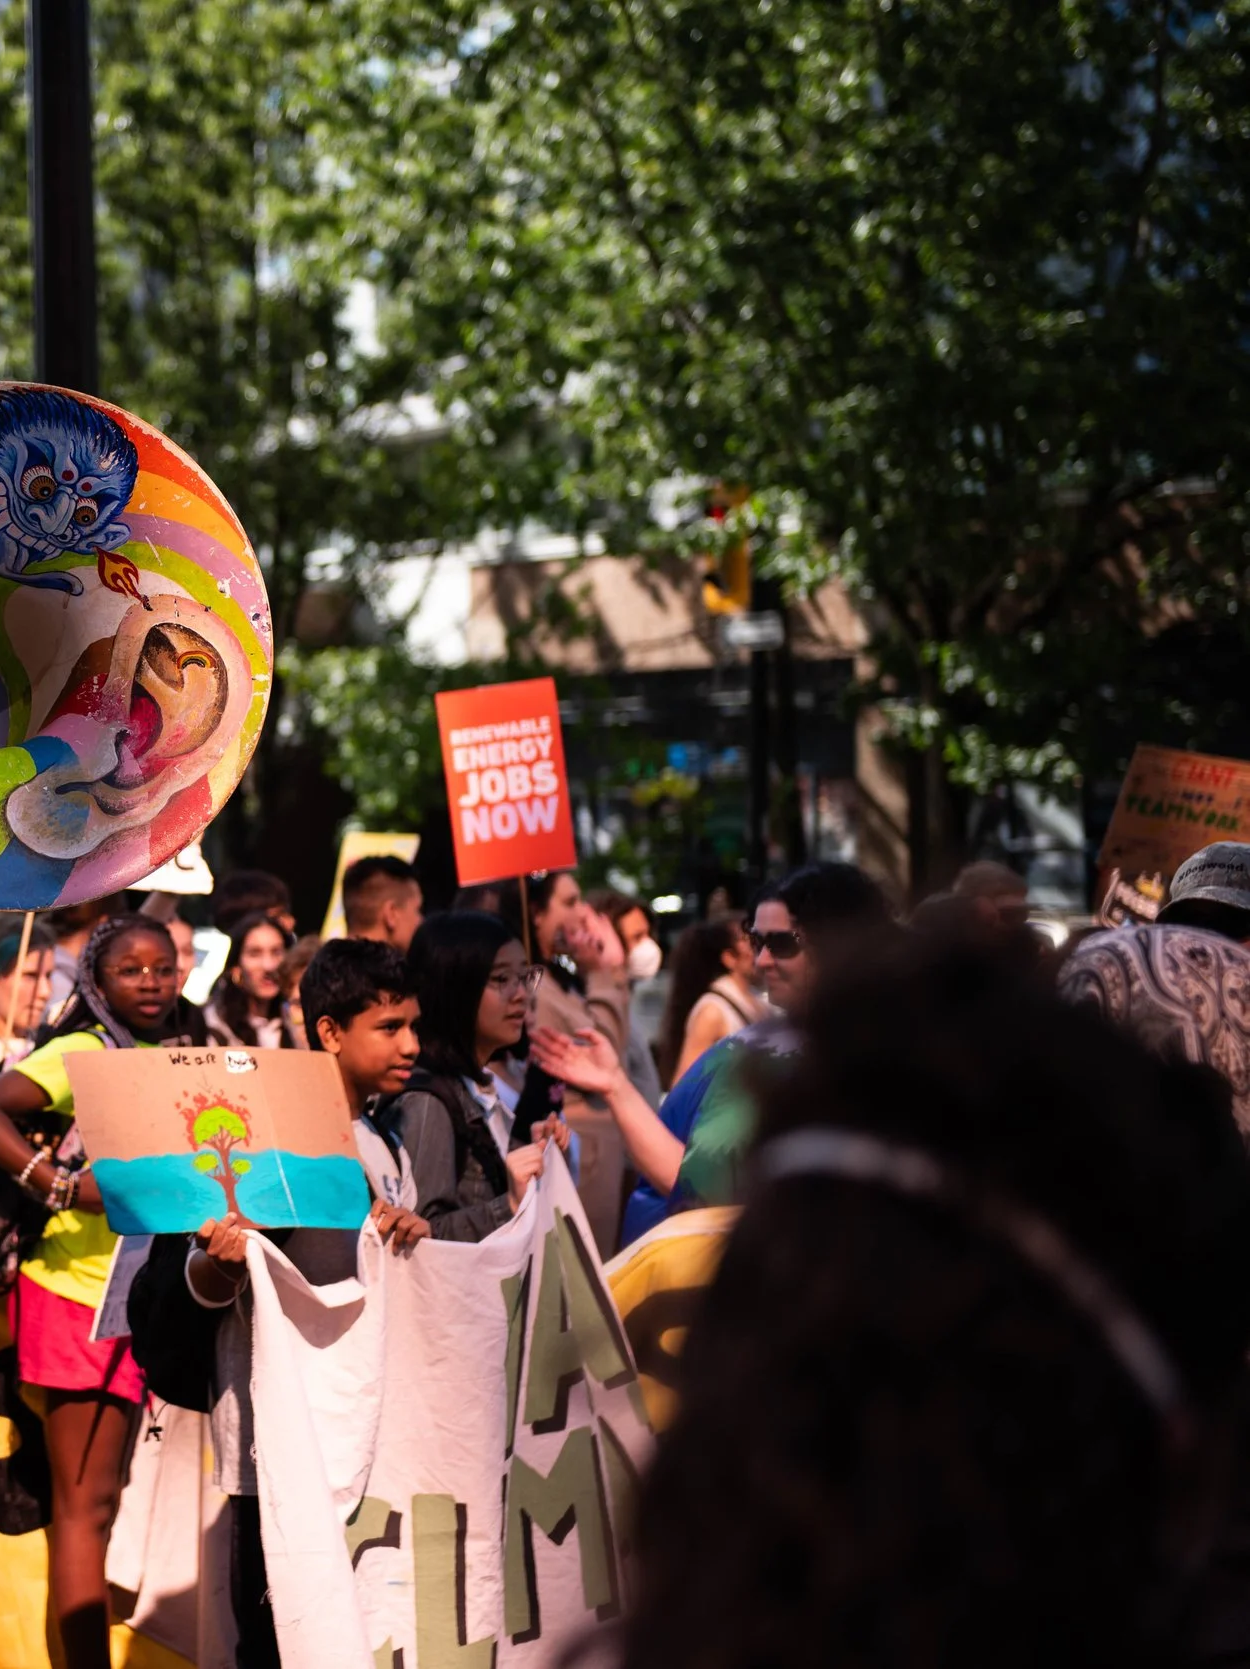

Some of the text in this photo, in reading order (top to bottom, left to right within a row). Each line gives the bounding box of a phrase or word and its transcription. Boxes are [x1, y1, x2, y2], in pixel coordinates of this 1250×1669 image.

[450, 715, 551, 745] RENEWABLE
[453, 734, 553, 774] ENERGY
[458, 760, 558, 808] JOBS
[461, 795, 559, 846] NOW
[168, 1052, 191, 1066] We
